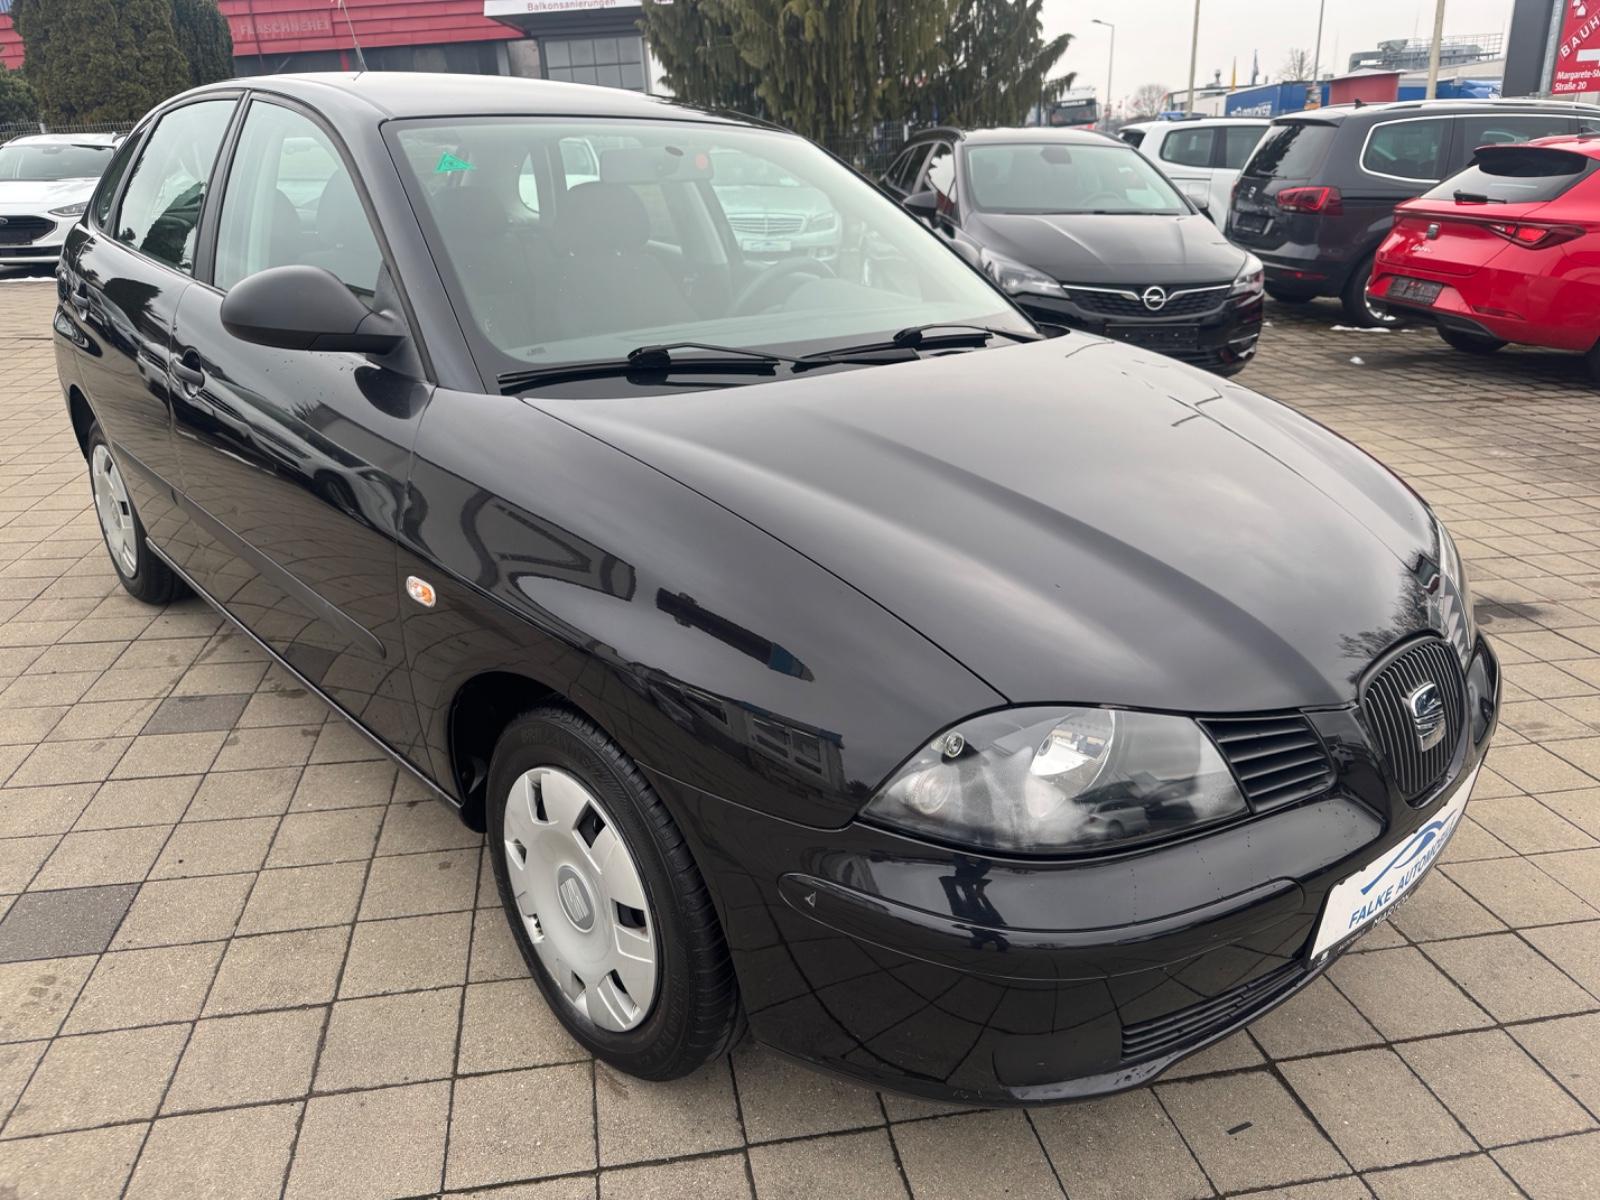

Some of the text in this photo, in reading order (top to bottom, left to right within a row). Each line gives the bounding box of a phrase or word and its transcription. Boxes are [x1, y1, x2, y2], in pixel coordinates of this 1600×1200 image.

[527, 0, 616, 11] Balkonsanierungen
[1555, 81, 1587, 91] Straße 20
[1348, 884, 1394, 929] FALKE
